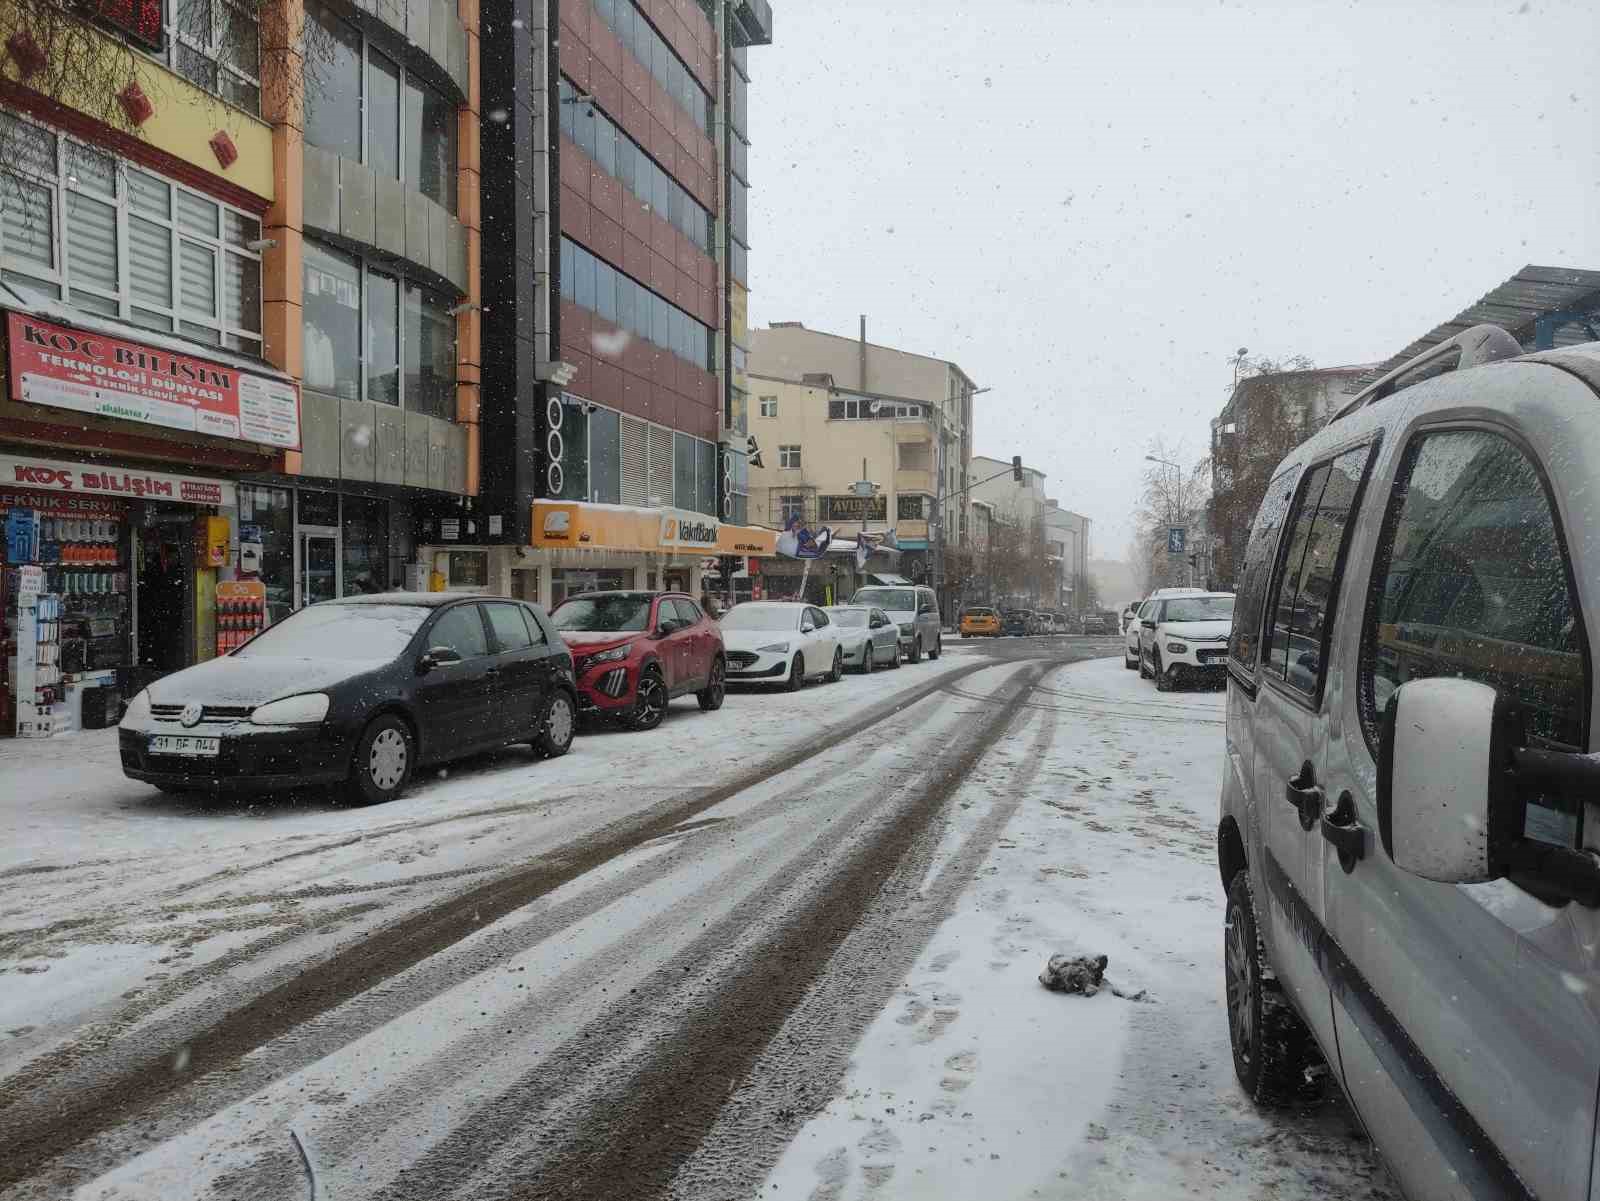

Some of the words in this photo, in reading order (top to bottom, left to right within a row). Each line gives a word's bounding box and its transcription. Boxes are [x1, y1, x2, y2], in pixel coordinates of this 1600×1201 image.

[24, 325, 105, 362] KOÇ
[38, 352, 147, 385] TEKNOLOJİ
[152, 376, 224, 402] DÜNYASI
[15, 465, 73, 489] KOÇ
[81, 471, 172, 497] BİLİŞİM
[833, 499, 885, 512] AVUAT
